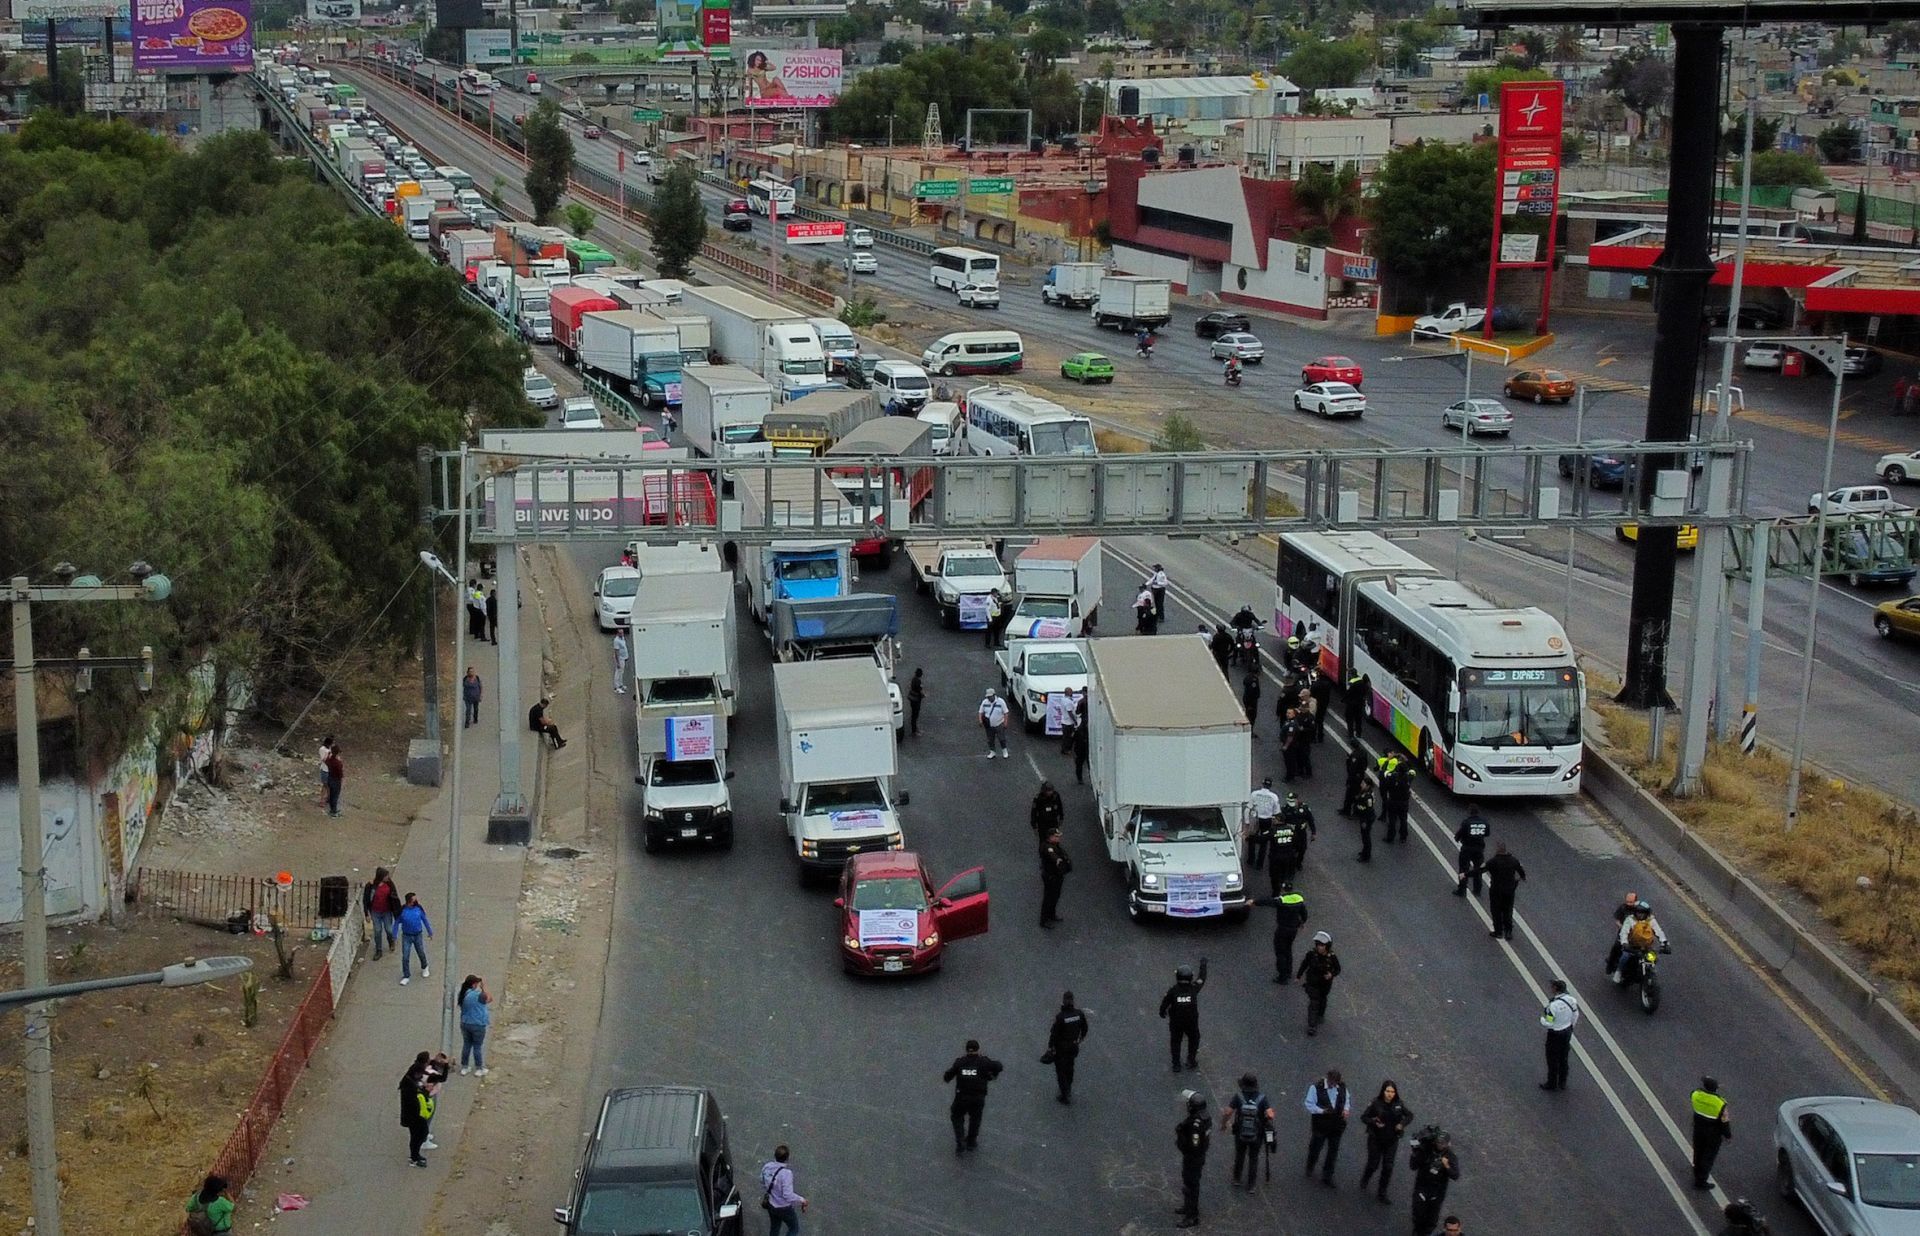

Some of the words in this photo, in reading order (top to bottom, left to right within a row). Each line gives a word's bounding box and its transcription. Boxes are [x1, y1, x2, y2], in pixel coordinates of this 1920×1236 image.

[785, 57, 826, 65] CARNIVAL
[783, 65, 840, 78] FASHION
[1512, 670, 1545, 680] EXPRESS
